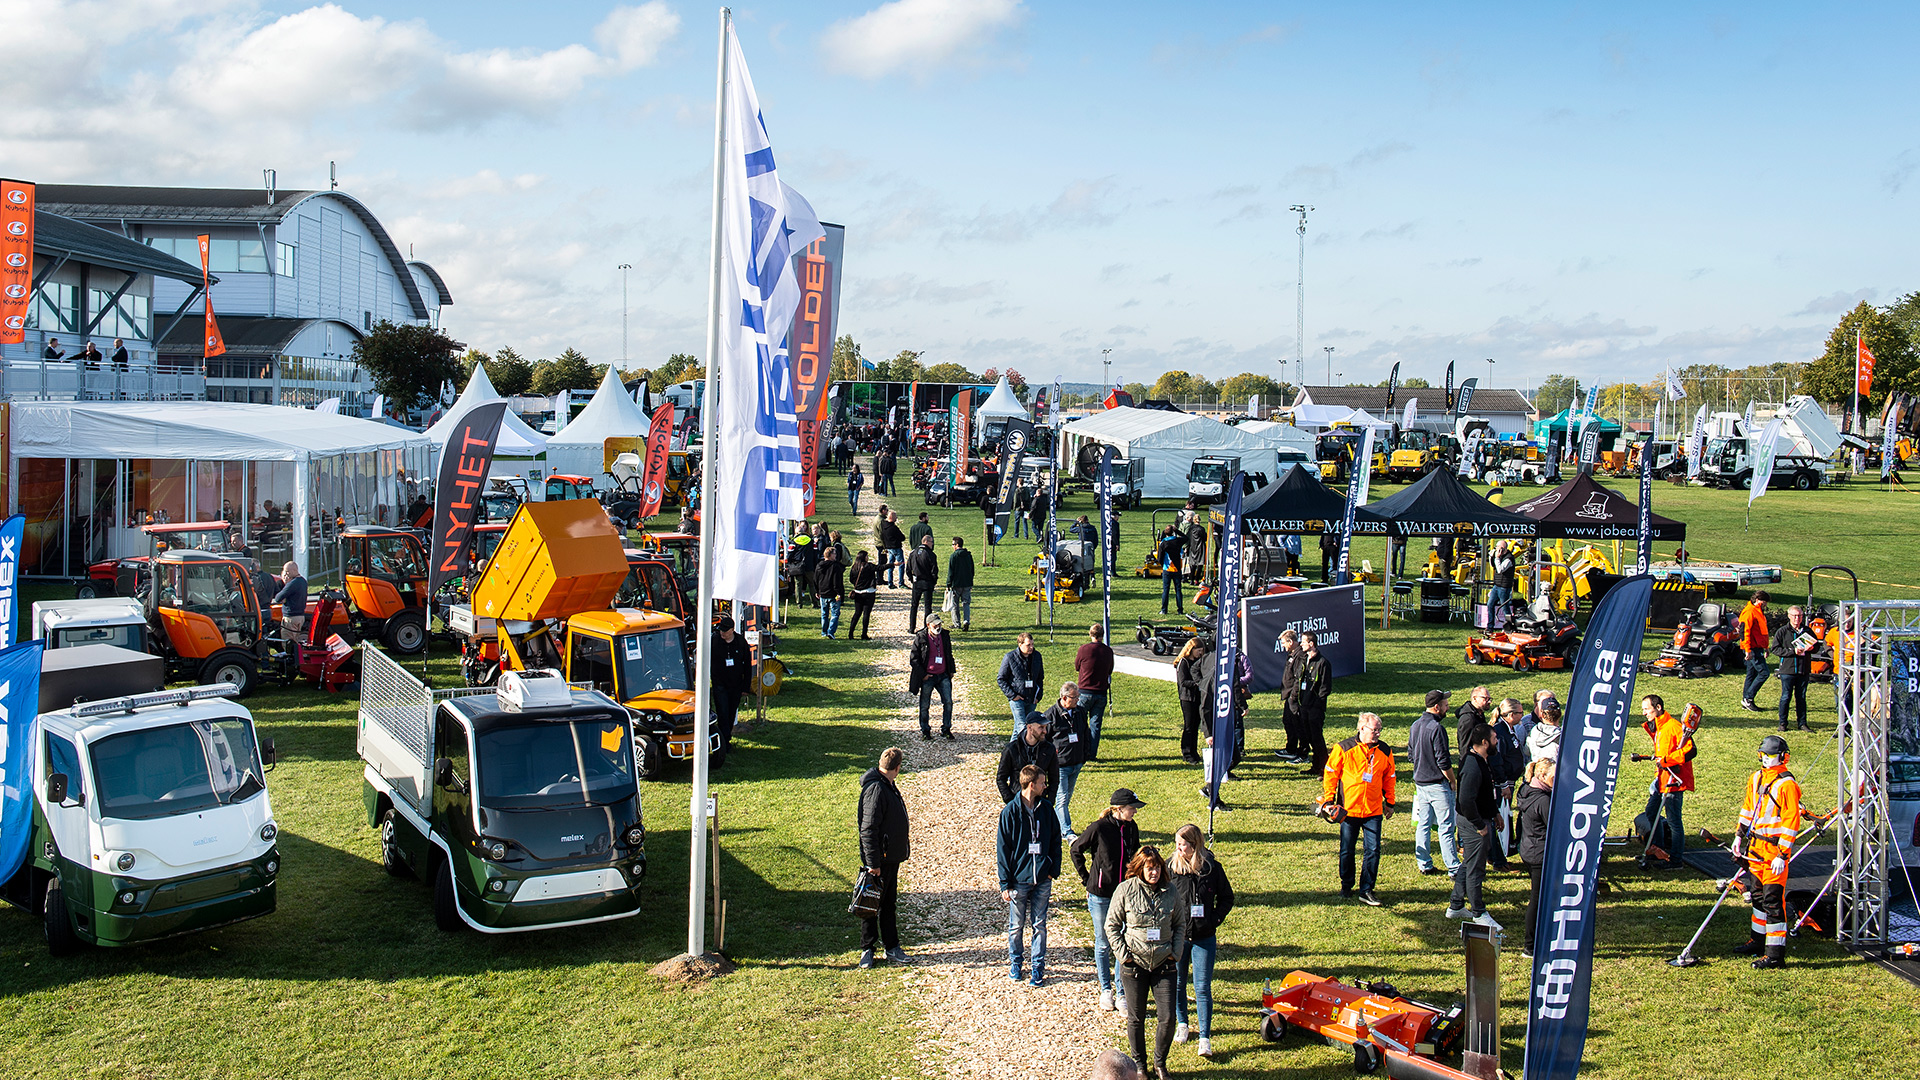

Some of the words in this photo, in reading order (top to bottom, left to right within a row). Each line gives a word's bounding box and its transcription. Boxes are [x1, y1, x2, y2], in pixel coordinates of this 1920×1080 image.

[1461, 388, 1471, 411] SWEEP
[649, 418, 669, 475] Kubota
[951, 406, 959, 475] RANSOMES
[957, 413, 966, 478] JACOBSEN
[1691, 416, 1702, 457] Stroman
[440, 426, 488, 571] NYHET
[998, 453, 1018, 504] WALKER
[1246, 518, 1305, 533] WALKER
[1395, 521, 1454, 535] WALKER
[1472, 522, 1536, 537] MOWERS
[1286, 621, 1301, 633] DET
[1303, 616, 1328, 633] BÄSTA
[1602, 751, 1619, 817] WHEN
[1611, 699, 1625, 744] YOU
[1618, 652, 1634, 697] ARE
[1551, 648, 1619, 951] Husqvarna
[560, 834, 585, 843] melex
